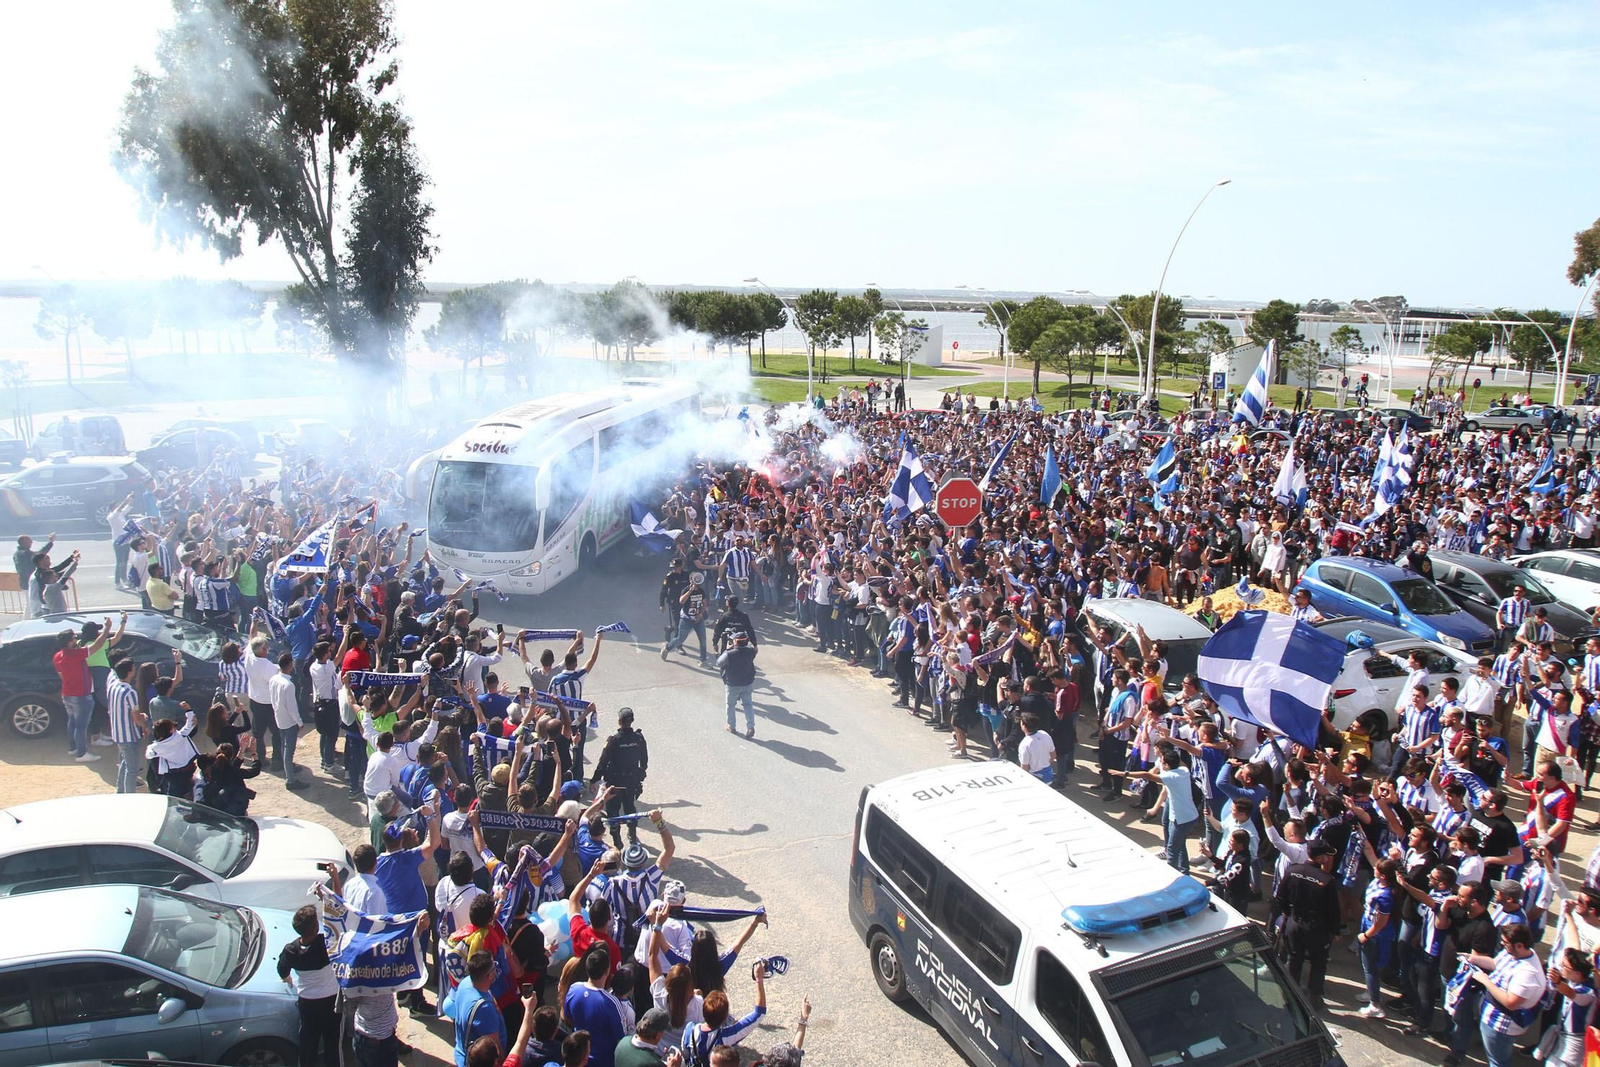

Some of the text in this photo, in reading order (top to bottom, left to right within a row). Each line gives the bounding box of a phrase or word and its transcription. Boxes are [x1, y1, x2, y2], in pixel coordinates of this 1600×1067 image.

[941, 497, 978, 509] STOP
[911, 775, 1013, 801] UPR-11B
[876, 799, 900, 821] UPR-11B
[371, 937, 409, 957] 1889
[381, 963, 391, 978] de
[391, 962, 416, 978] Huelva
[915, 953, 999, 1051] NACIONAL
